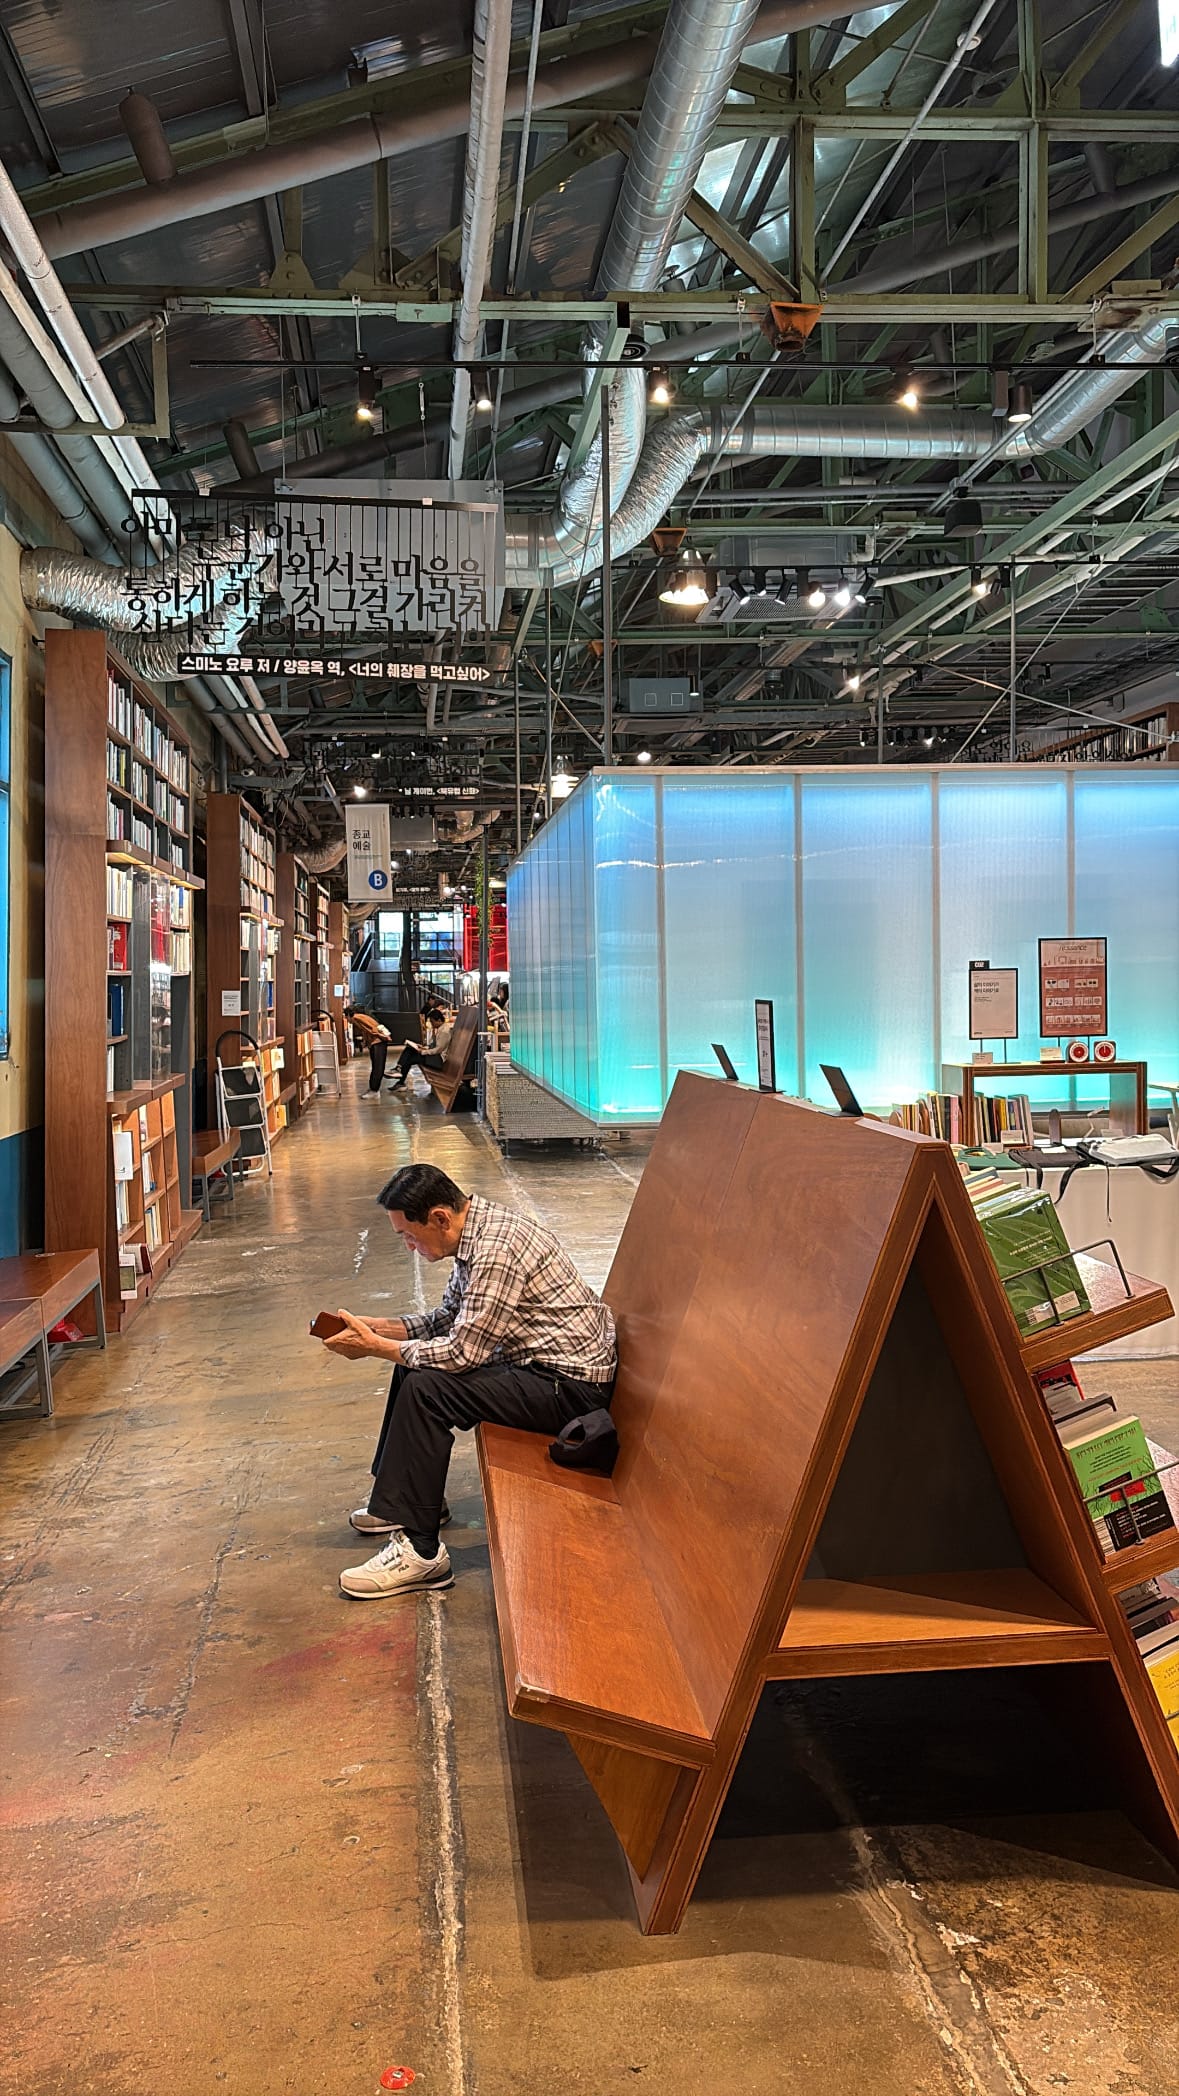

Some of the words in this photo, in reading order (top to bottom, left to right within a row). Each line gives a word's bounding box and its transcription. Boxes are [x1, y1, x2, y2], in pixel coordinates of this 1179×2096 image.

[224, 514, 258, 549] 나
[264, 516, 326, 552] 아닌
[192, 548, 322, 584] 누군가와
[323, 552, 388, 586] 서로
[391, 554, 486, 592] 마음을
[120, 578, 214, 613] 통하게
[396, 588, 487, 626] 가리켜
[132, 610, 229, 645] 산다는
[181, 656, 222, 671] 스미노
[226, 657, 253, 672] 요루
[257, 658, 270, 673] 저
[273, 659, 280, 673] /
[283, 659, 324, 675] 양윤옥
[327, 661, 345, 676] 역,
[387, 663, 426, 679] 췌장을
[352, 829, 371, 839] 종교
[352, 840, 371, 850] 예술
[374, 874, 383, 887] B
